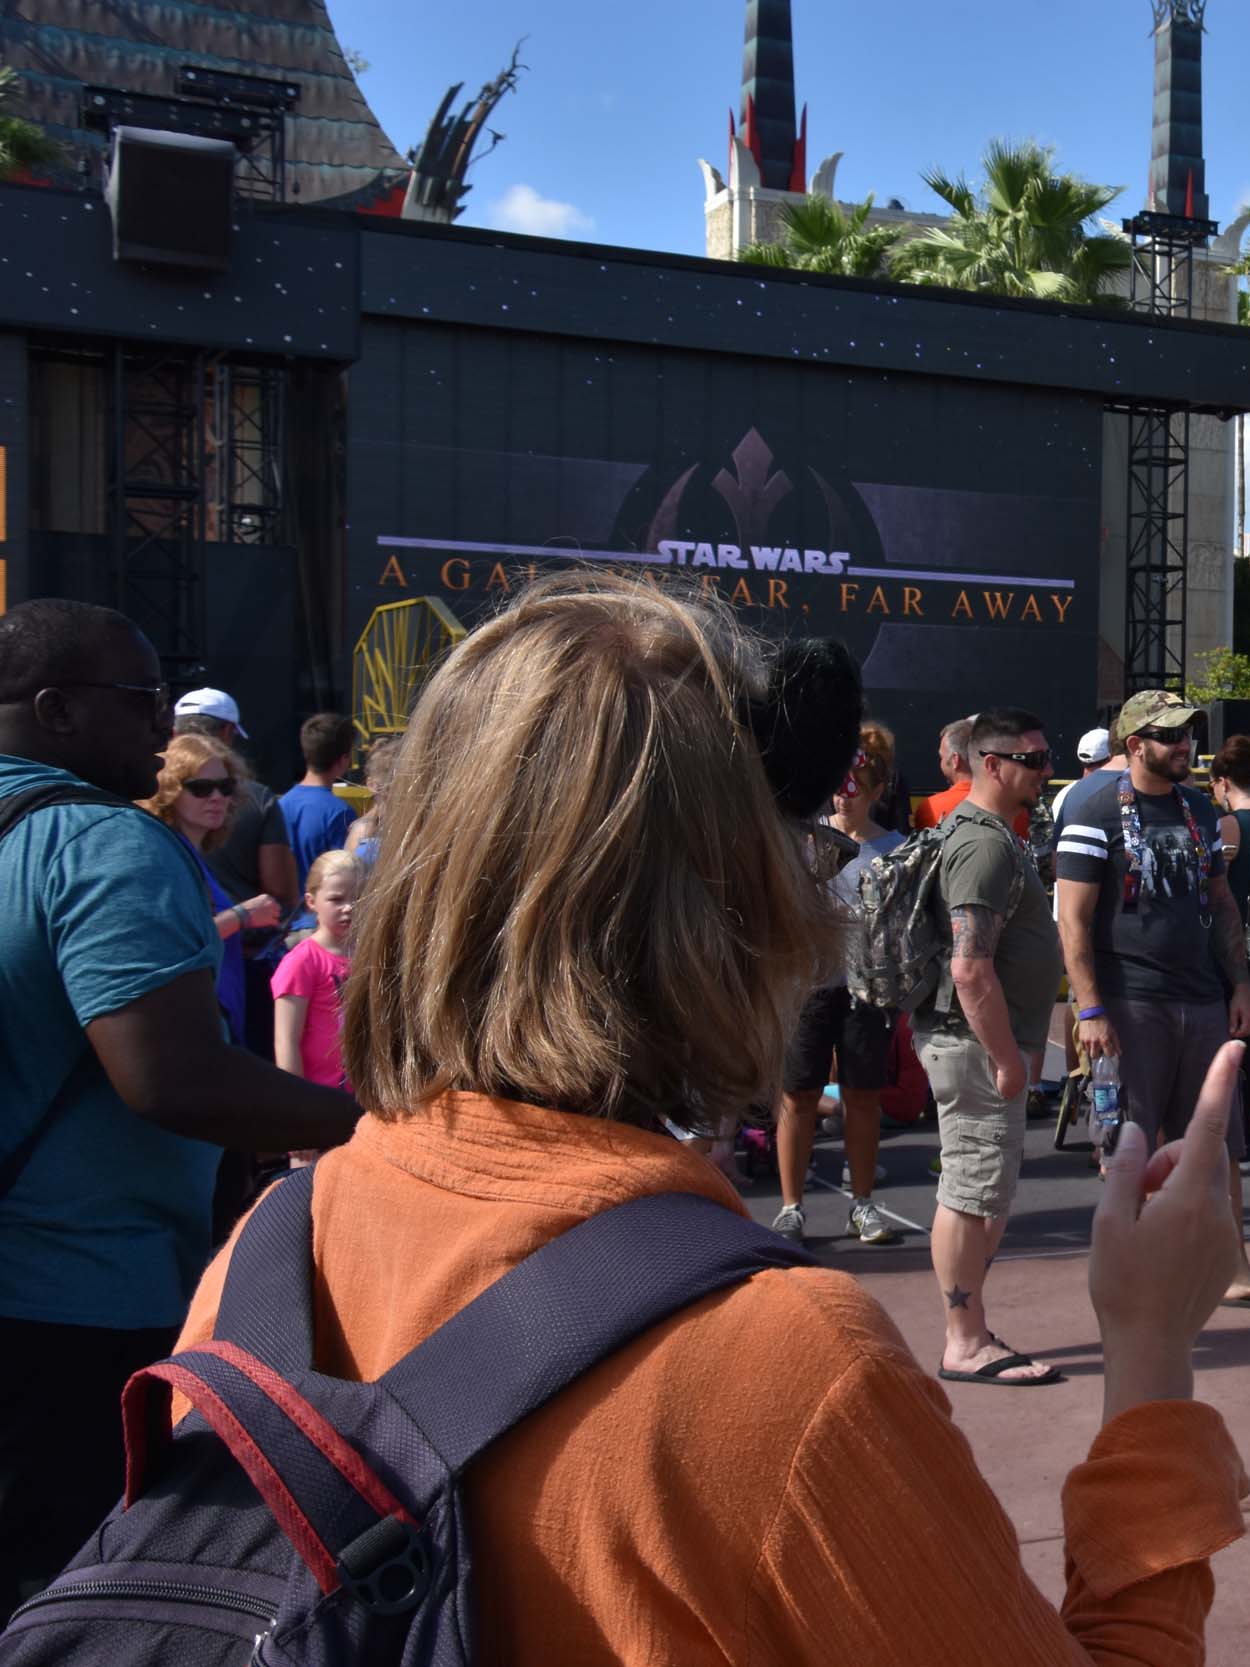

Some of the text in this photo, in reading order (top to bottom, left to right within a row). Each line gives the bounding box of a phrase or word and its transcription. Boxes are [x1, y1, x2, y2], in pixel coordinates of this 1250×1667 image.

[657, 540, 850, 575] STAR WARS
[378, 554, 408, 588] A
[840, 582, 925, 616] FAR
[951, 590, 1073, 623] AWAY
